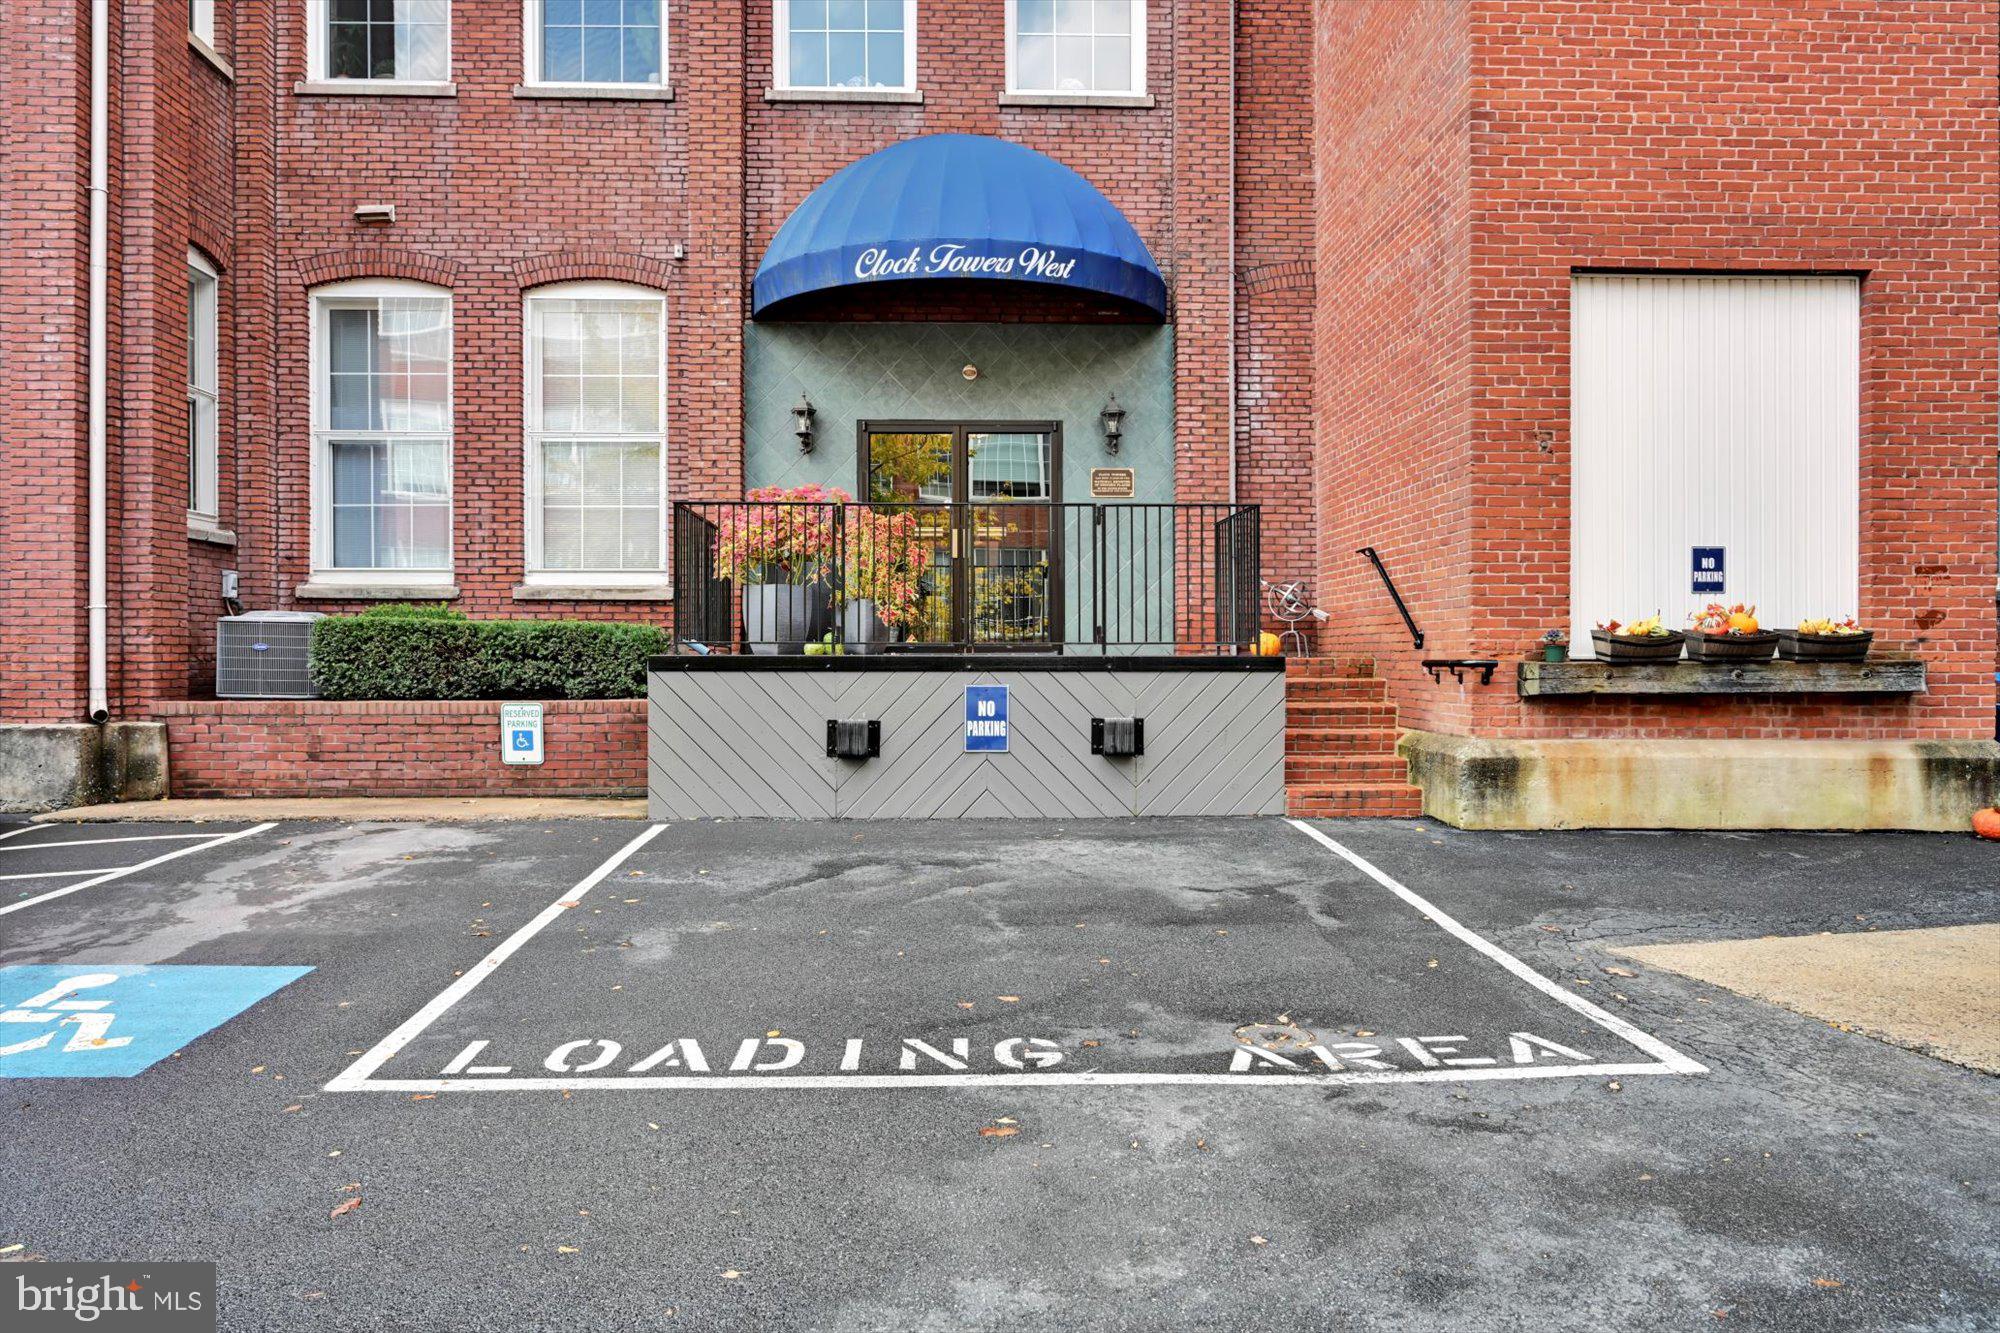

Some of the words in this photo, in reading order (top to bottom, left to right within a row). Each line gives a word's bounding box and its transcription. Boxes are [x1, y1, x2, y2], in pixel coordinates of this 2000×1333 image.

[854, 246, 921, 279] Clock
[925, 243, 1015, 274] Towers
[1018, 247, 1076, 279] West
[1701, 557, 1715, 569] NO
[1693, 571, 1724, 582] PARKING
[504, 709, 540, 718] RESERVED
[977, 700, 996, 717] NO
[507, 720, 538, 728] PARKING
[967, 720, 1007, 737] PARKING
[439, 1036, 1064, 1074] LOADING
[1229, 1032, 1596, 1073] AREA
